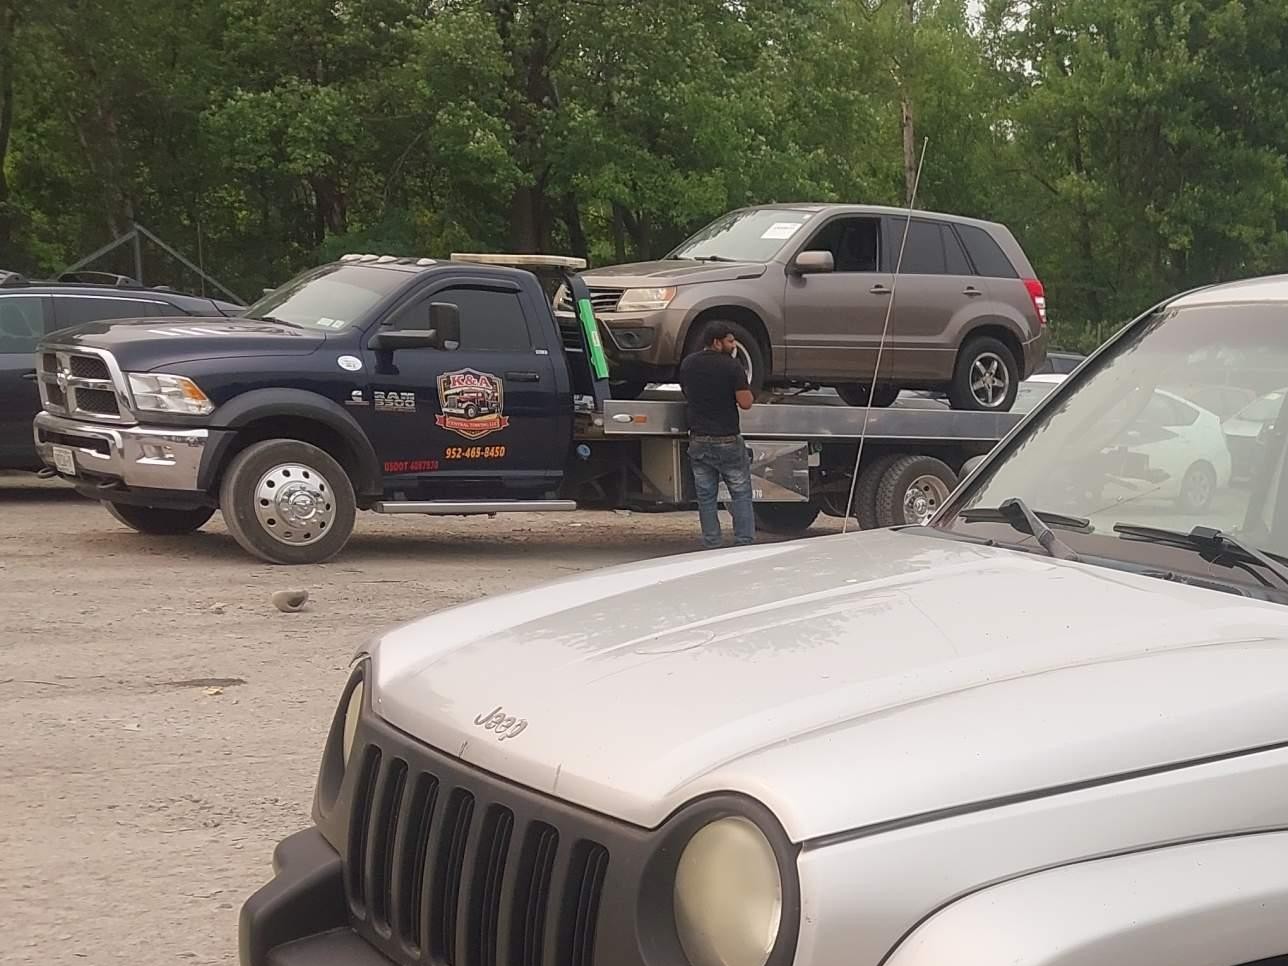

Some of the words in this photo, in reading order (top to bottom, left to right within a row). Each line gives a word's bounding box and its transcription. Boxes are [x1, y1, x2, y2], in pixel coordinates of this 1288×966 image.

[450, 374, 493, 389] K&A
[374, 391, 415, 400] RAM
[473, 706, 529, 741] Jeep
